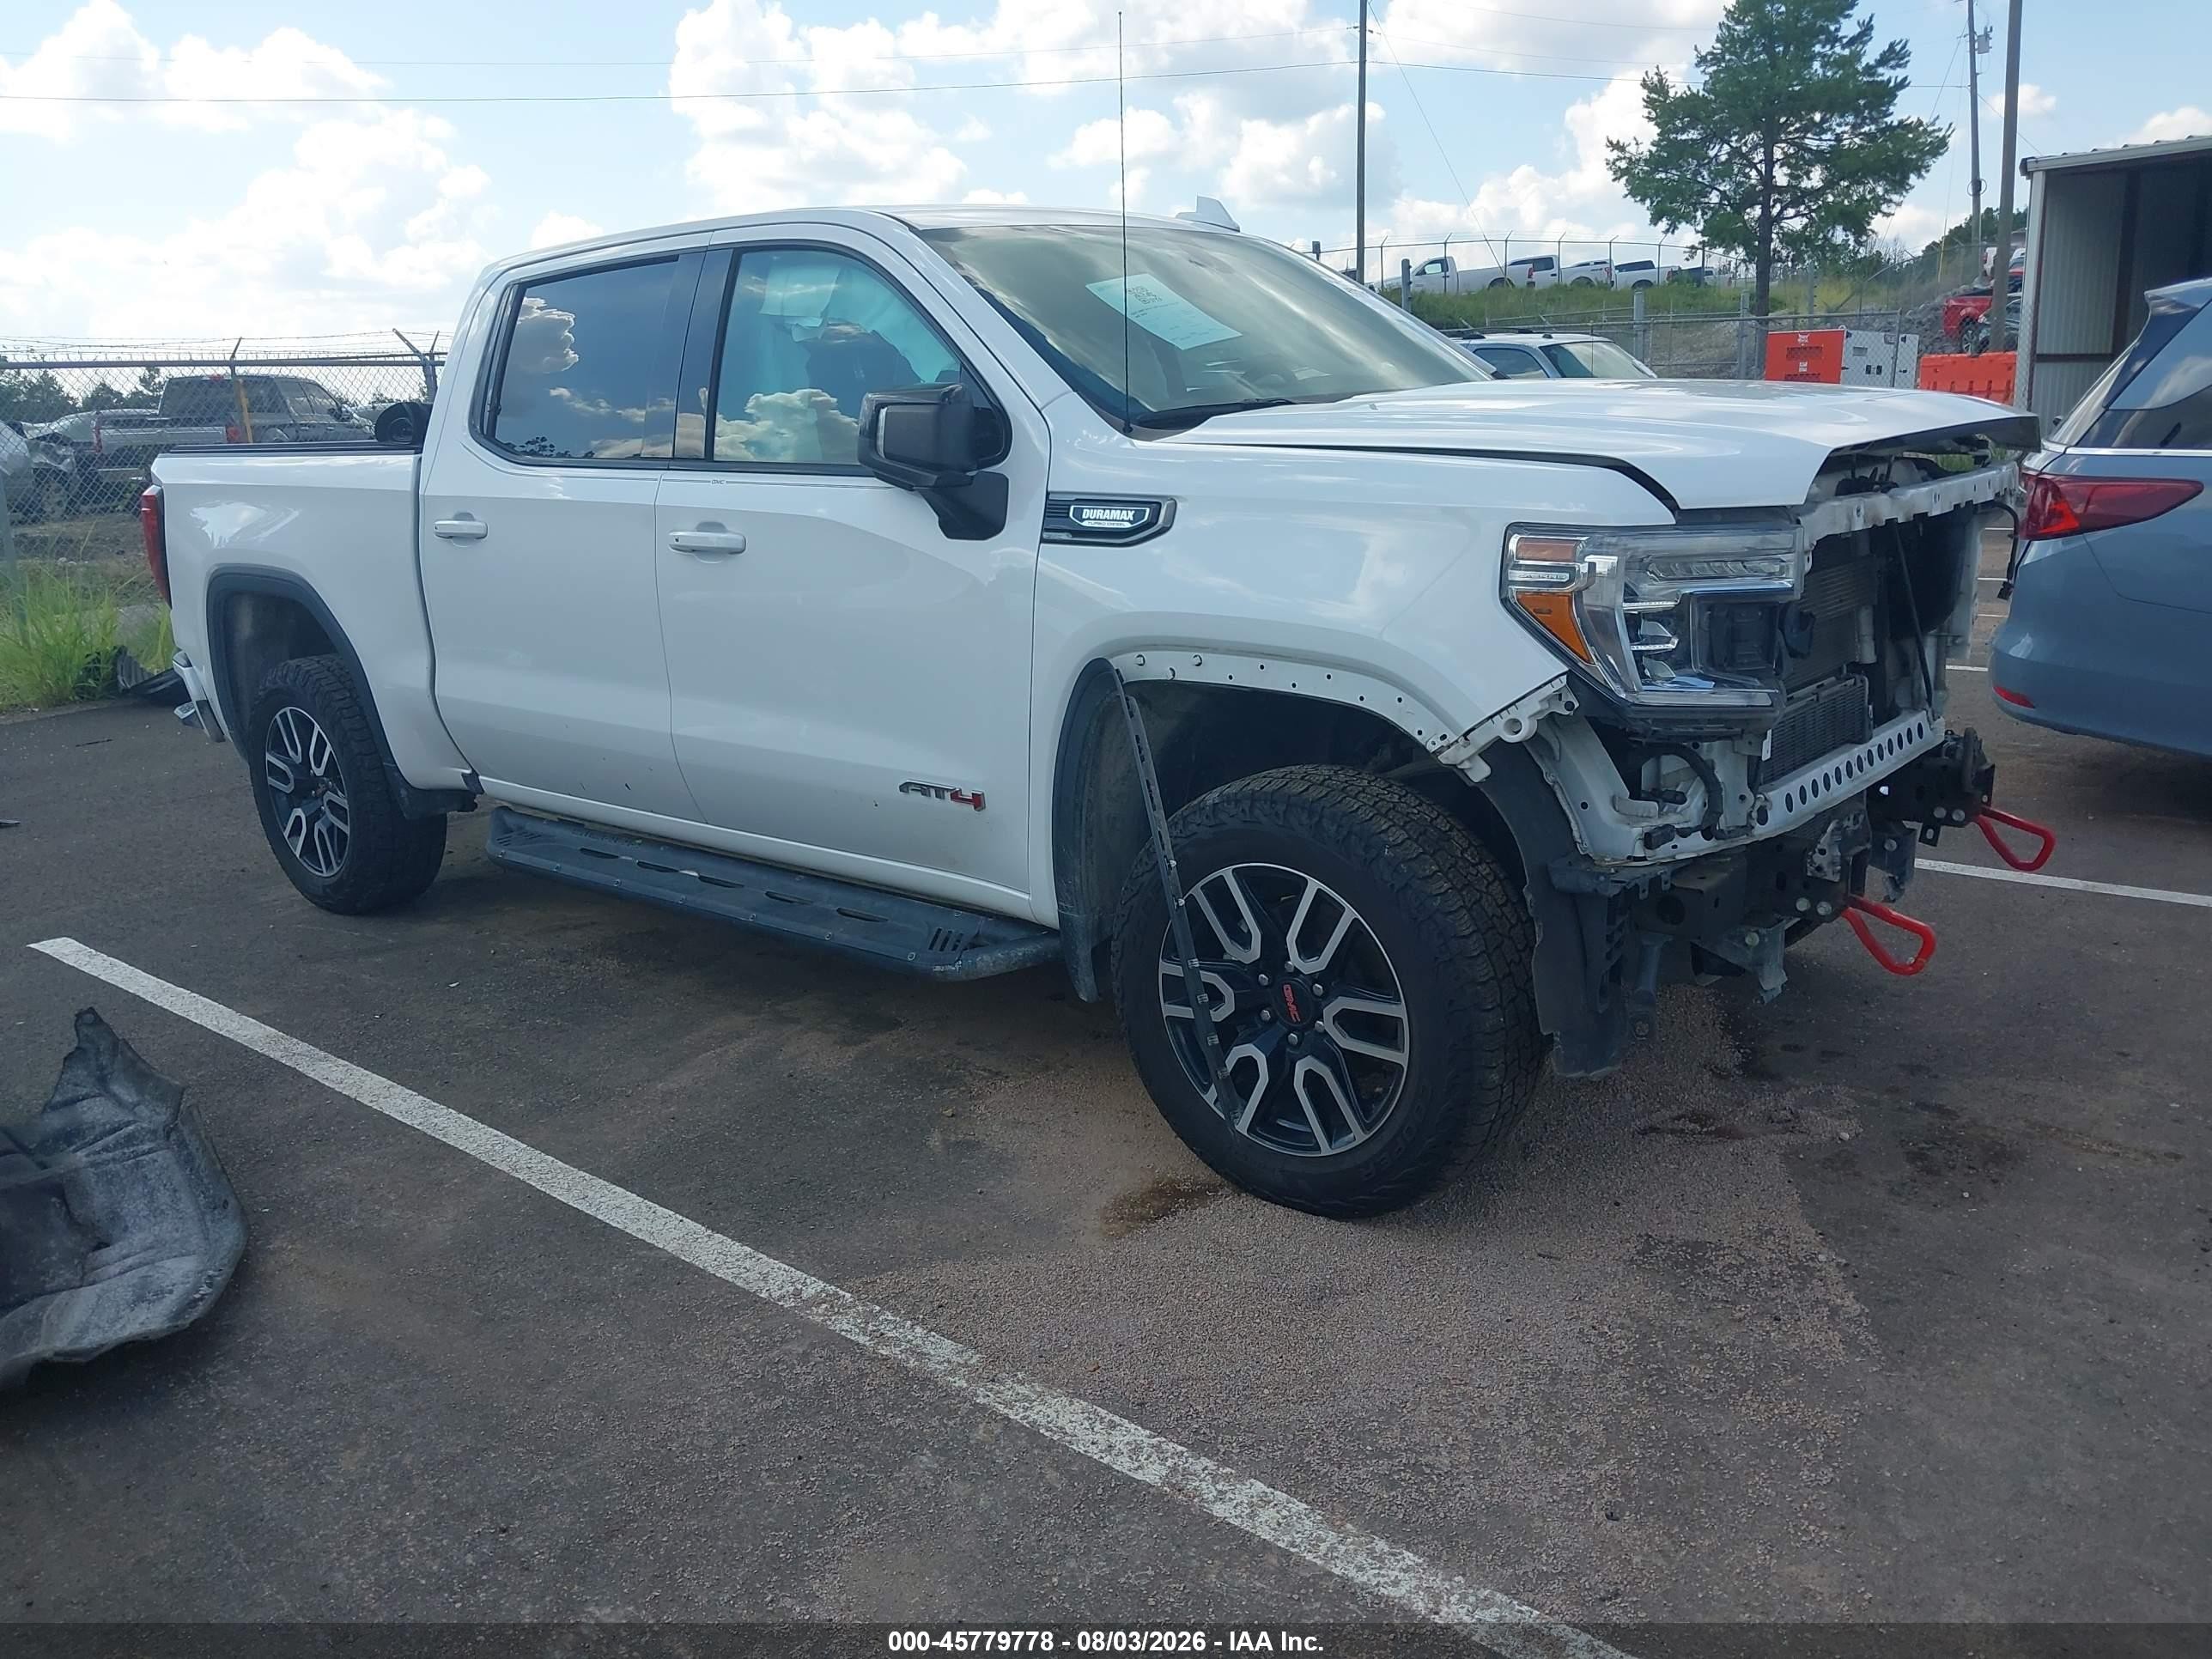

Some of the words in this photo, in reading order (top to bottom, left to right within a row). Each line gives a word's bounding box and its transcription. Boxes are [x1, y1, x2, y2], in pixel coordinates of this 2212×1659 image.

[1082, 508, 1135, 520] DURAMAX
[899, 779, 986, 811] AT4
[1283, 984, 1301, 1022] GMC
